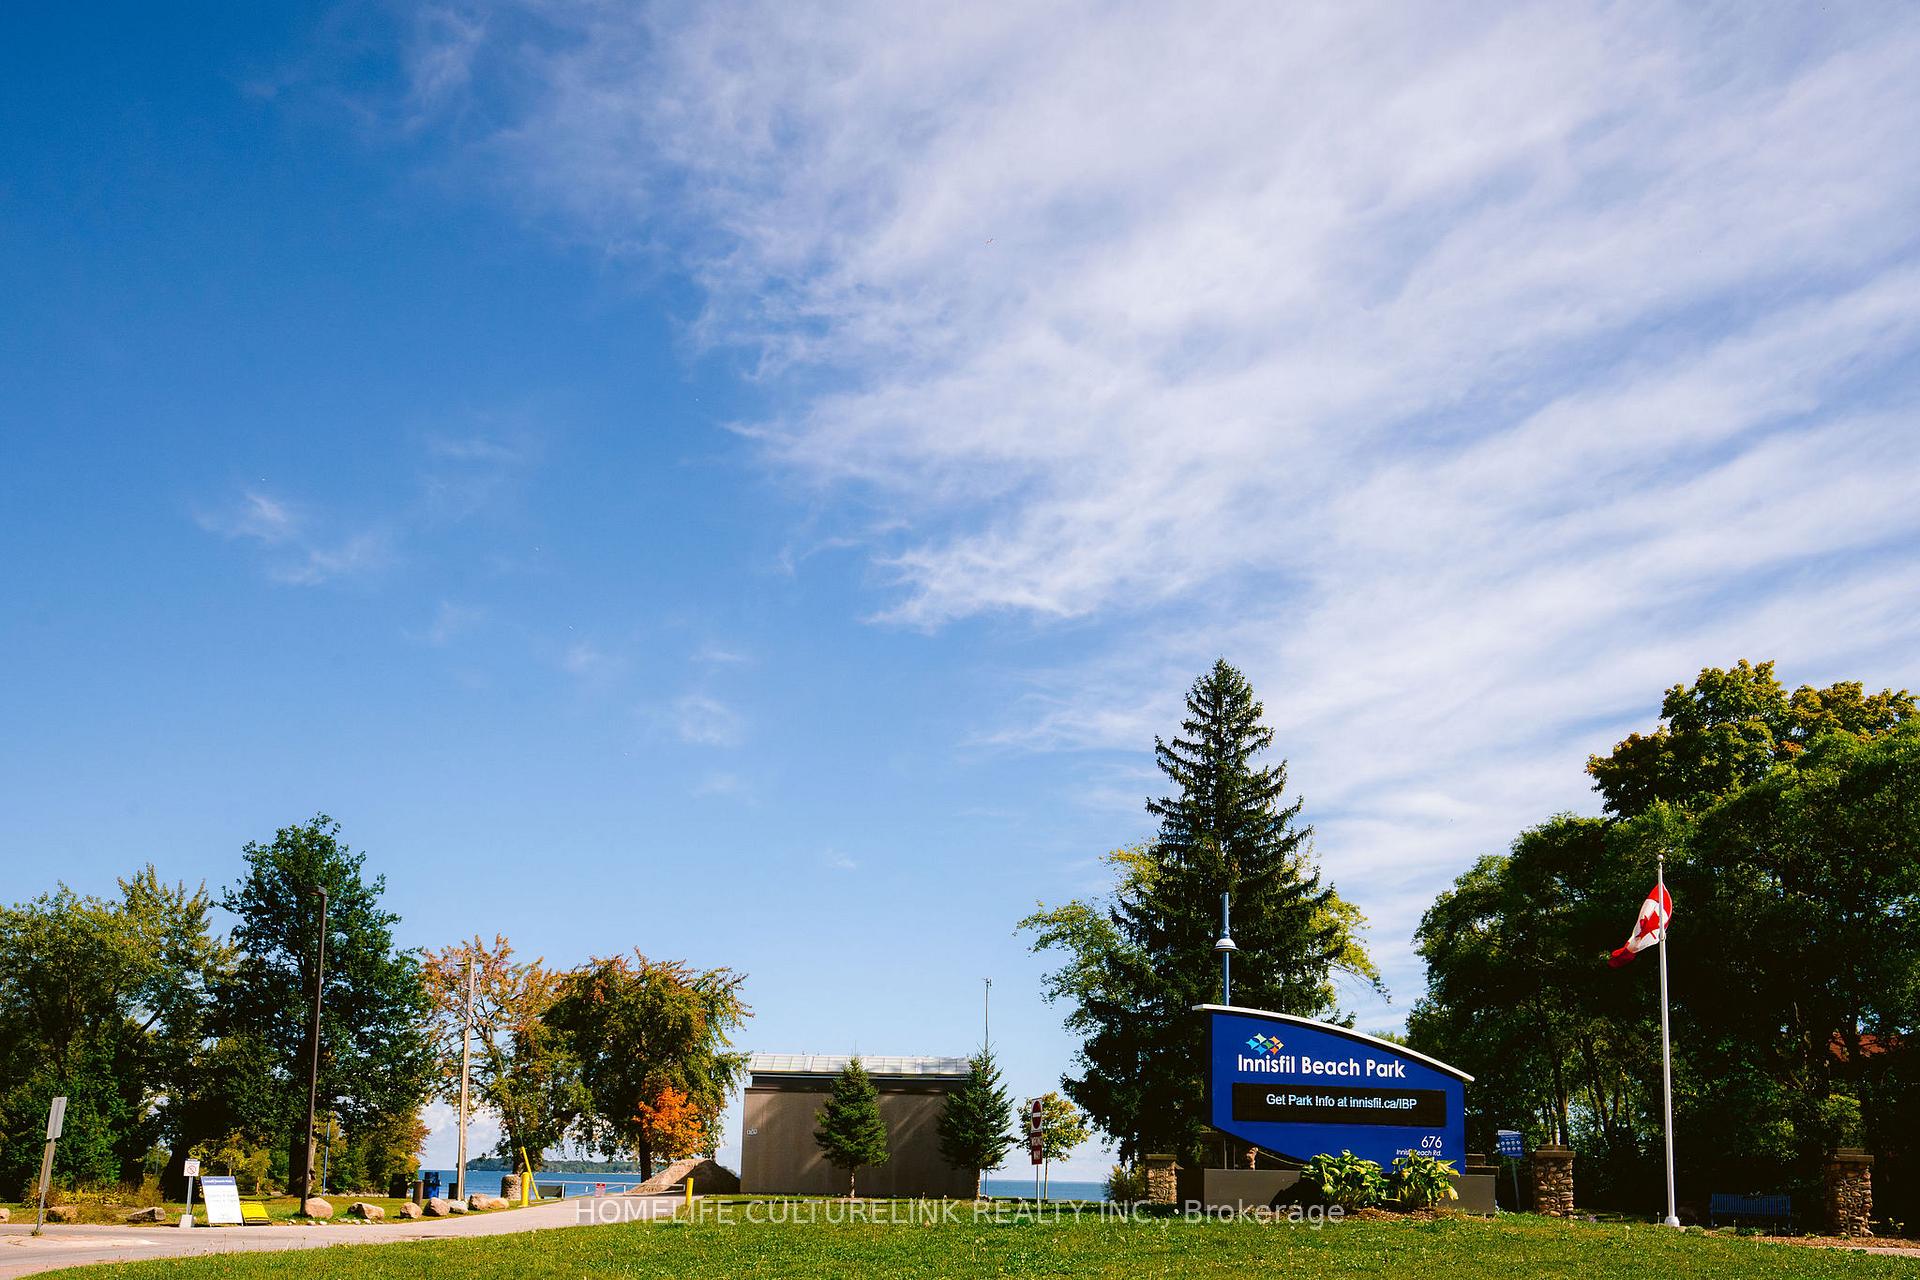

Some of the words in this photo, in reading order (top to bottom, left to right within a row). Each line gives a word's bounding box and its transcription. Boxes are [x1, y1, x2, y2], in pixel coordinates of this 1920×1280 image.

[1238, 1054, 1295, 1073] Innisfil
[1301, 1056, 1360, 1076] Beach
[1366, 1059, 1406, 1078] Park
[1266, 1094, 1286, 1105] Get
[1288, 1094, 1313, 1106] Park
[1315, 1095, 1335, 1107] Info
[1337, 1097, 1348, 1107] at
[1350, 1097, 1417, 1110] innisfil.ca/IBP
[1421, 1135, 1443, 1149] 676
